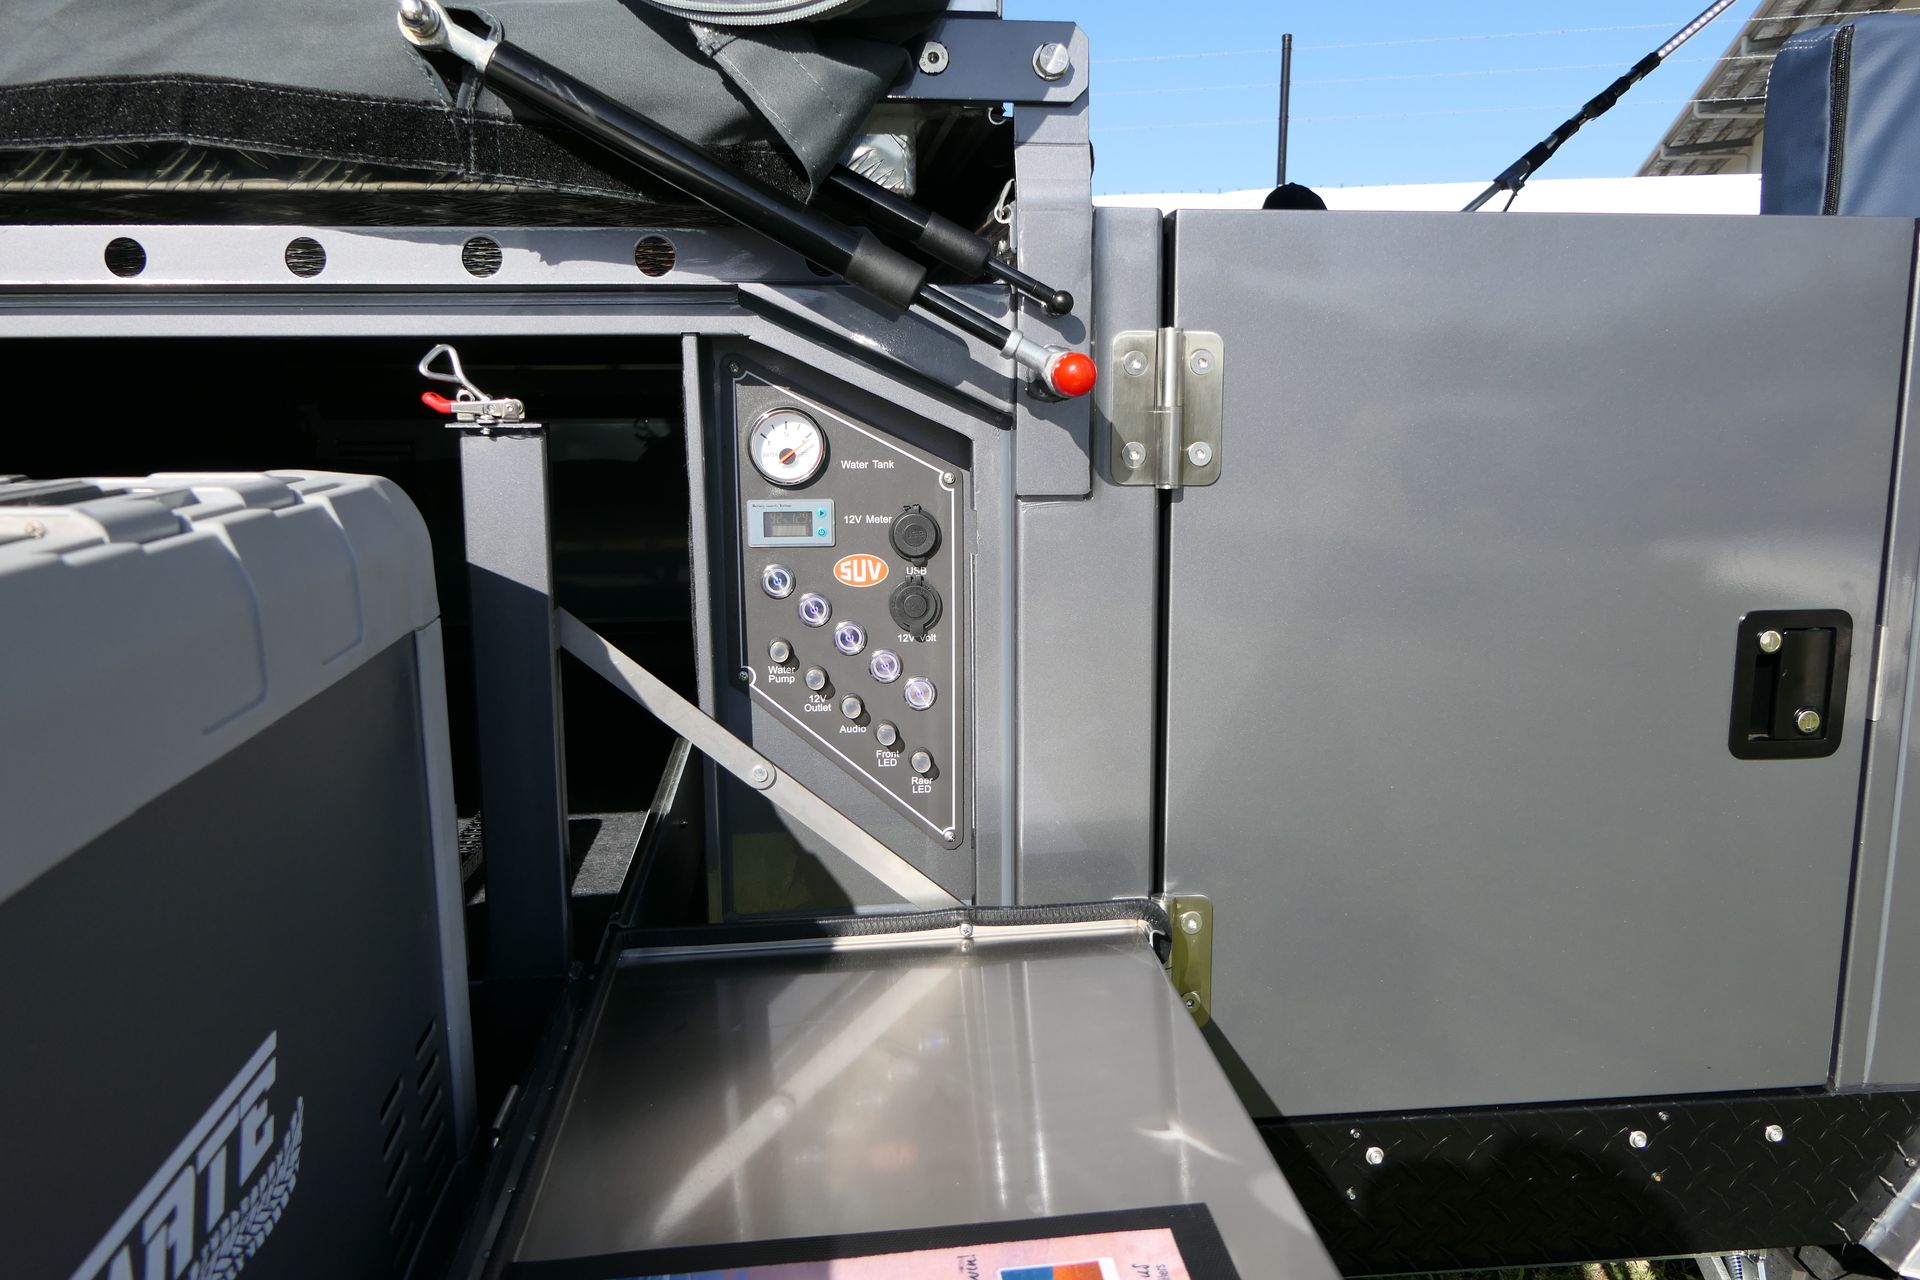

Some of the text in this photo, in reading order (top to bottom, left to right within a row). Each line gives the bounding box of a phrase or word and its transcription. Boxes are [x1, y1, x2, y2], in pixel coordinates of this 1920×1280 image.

[841, 460, 895, 469] Water Tank
[844, 515, 893, 524] 12V Meter
[840, 559, 882, 583] SUV
[906, 567, 927, 576] USB
[898, 634, 915, 643] 12V
[768, 666, 795, 674] Water
[768, 675, 795, 684] Pump
[809, 695, 827, 703] 12V
[804, 703, 832, 712] Outlet
[839, 725, 867, 733] Audio
[876, 750, 900, 758] Front
[878, 759, 897, 767] LED
[912, 777, 933, 785] Raer
[912, 785, 932, 793] LED
